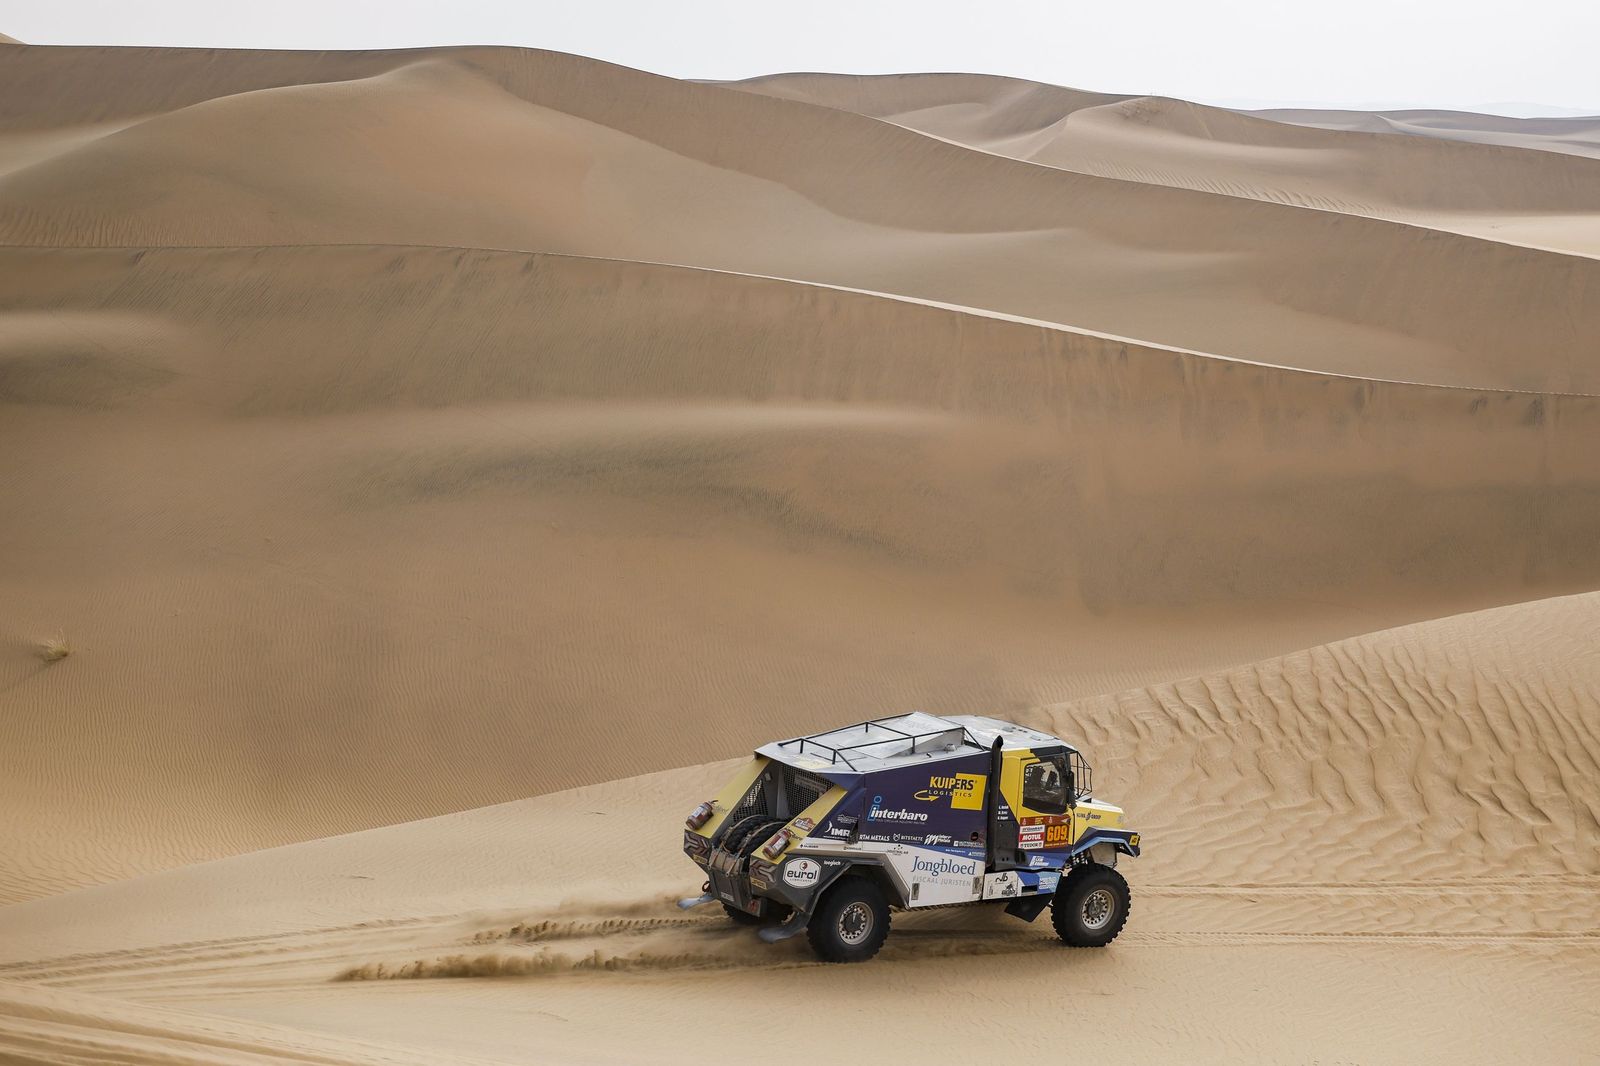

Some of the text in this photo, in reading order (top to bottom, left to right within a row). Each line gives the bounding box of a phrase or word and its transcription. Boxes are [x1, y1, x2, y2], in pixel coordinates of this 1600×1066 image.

[930, 776, 974, 791] KUIPERS
[928, 790, 972, 798] LOGISTICS
[870, 807, 928, 821] interbaro
[1046, 825, 1067, 842] 609
[911, 855, 976, 877] Jongbloed
[786, 870, 818, 880] eurol
[912, 876, 939, 884] FISCAAL
